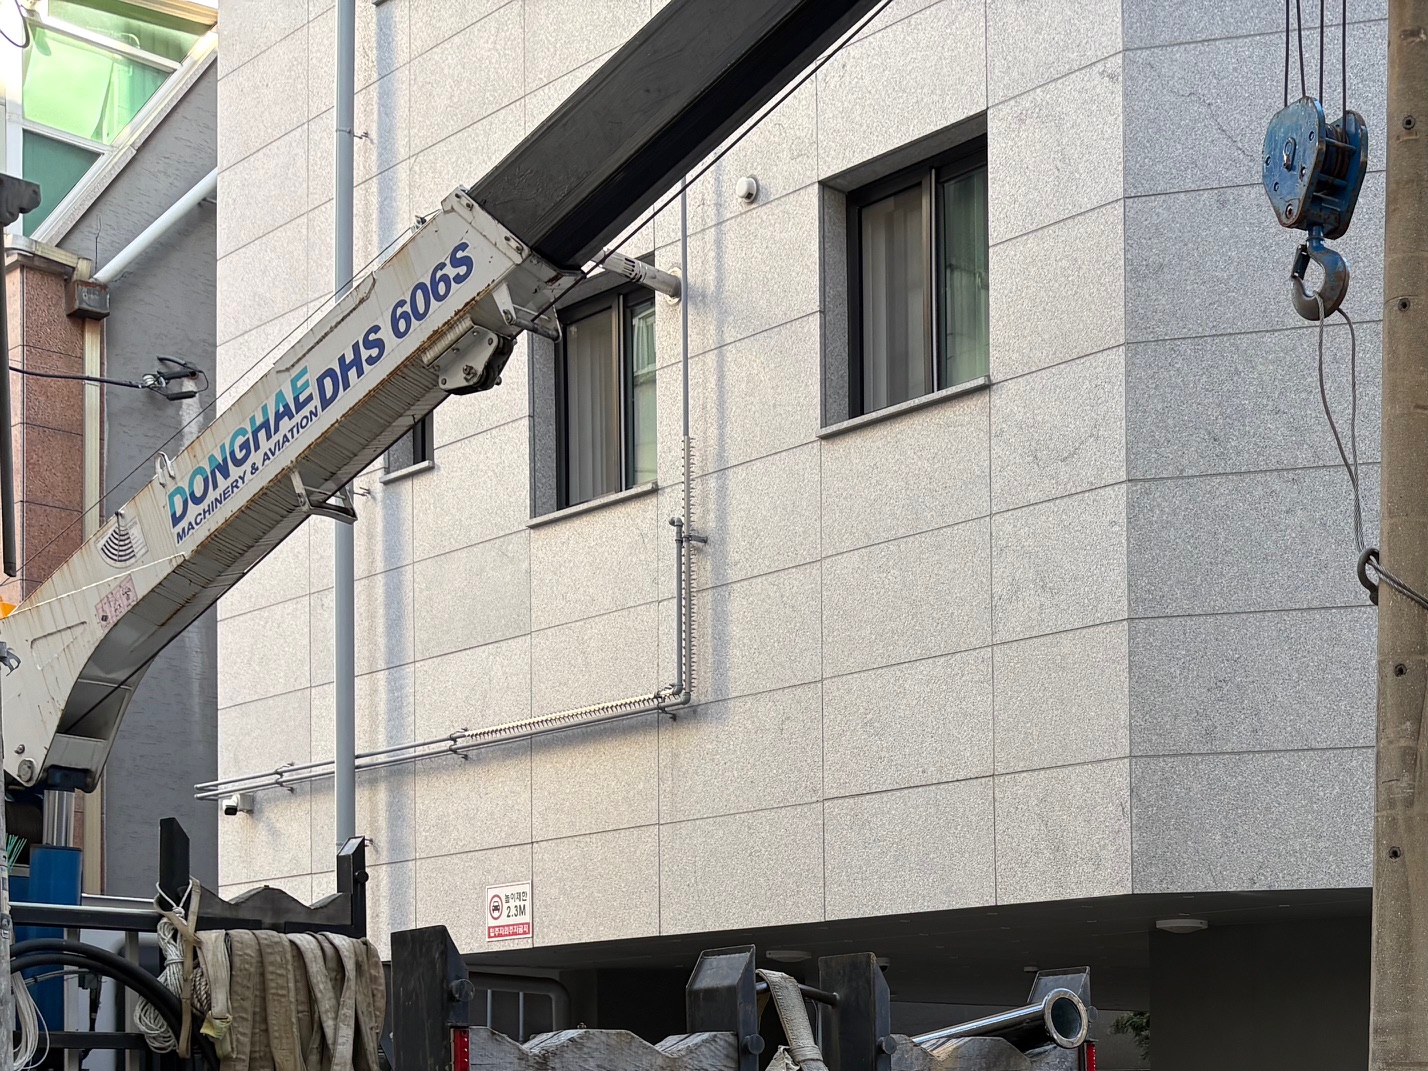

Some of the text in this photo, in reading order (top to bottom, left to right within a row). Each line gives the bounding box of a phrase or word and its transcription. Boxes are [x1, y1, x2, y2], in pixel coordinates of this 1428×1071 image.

[315, 241, 474, 413] DHS 606S
[167, 365, 313, 529] DONGHAE
[176, 475, 247, 544] MACHINERY
[249, 463, 259, 475] &
[261, 405, 319, 467] AVIATION
[506, 904, 526, 918] 2.3M
